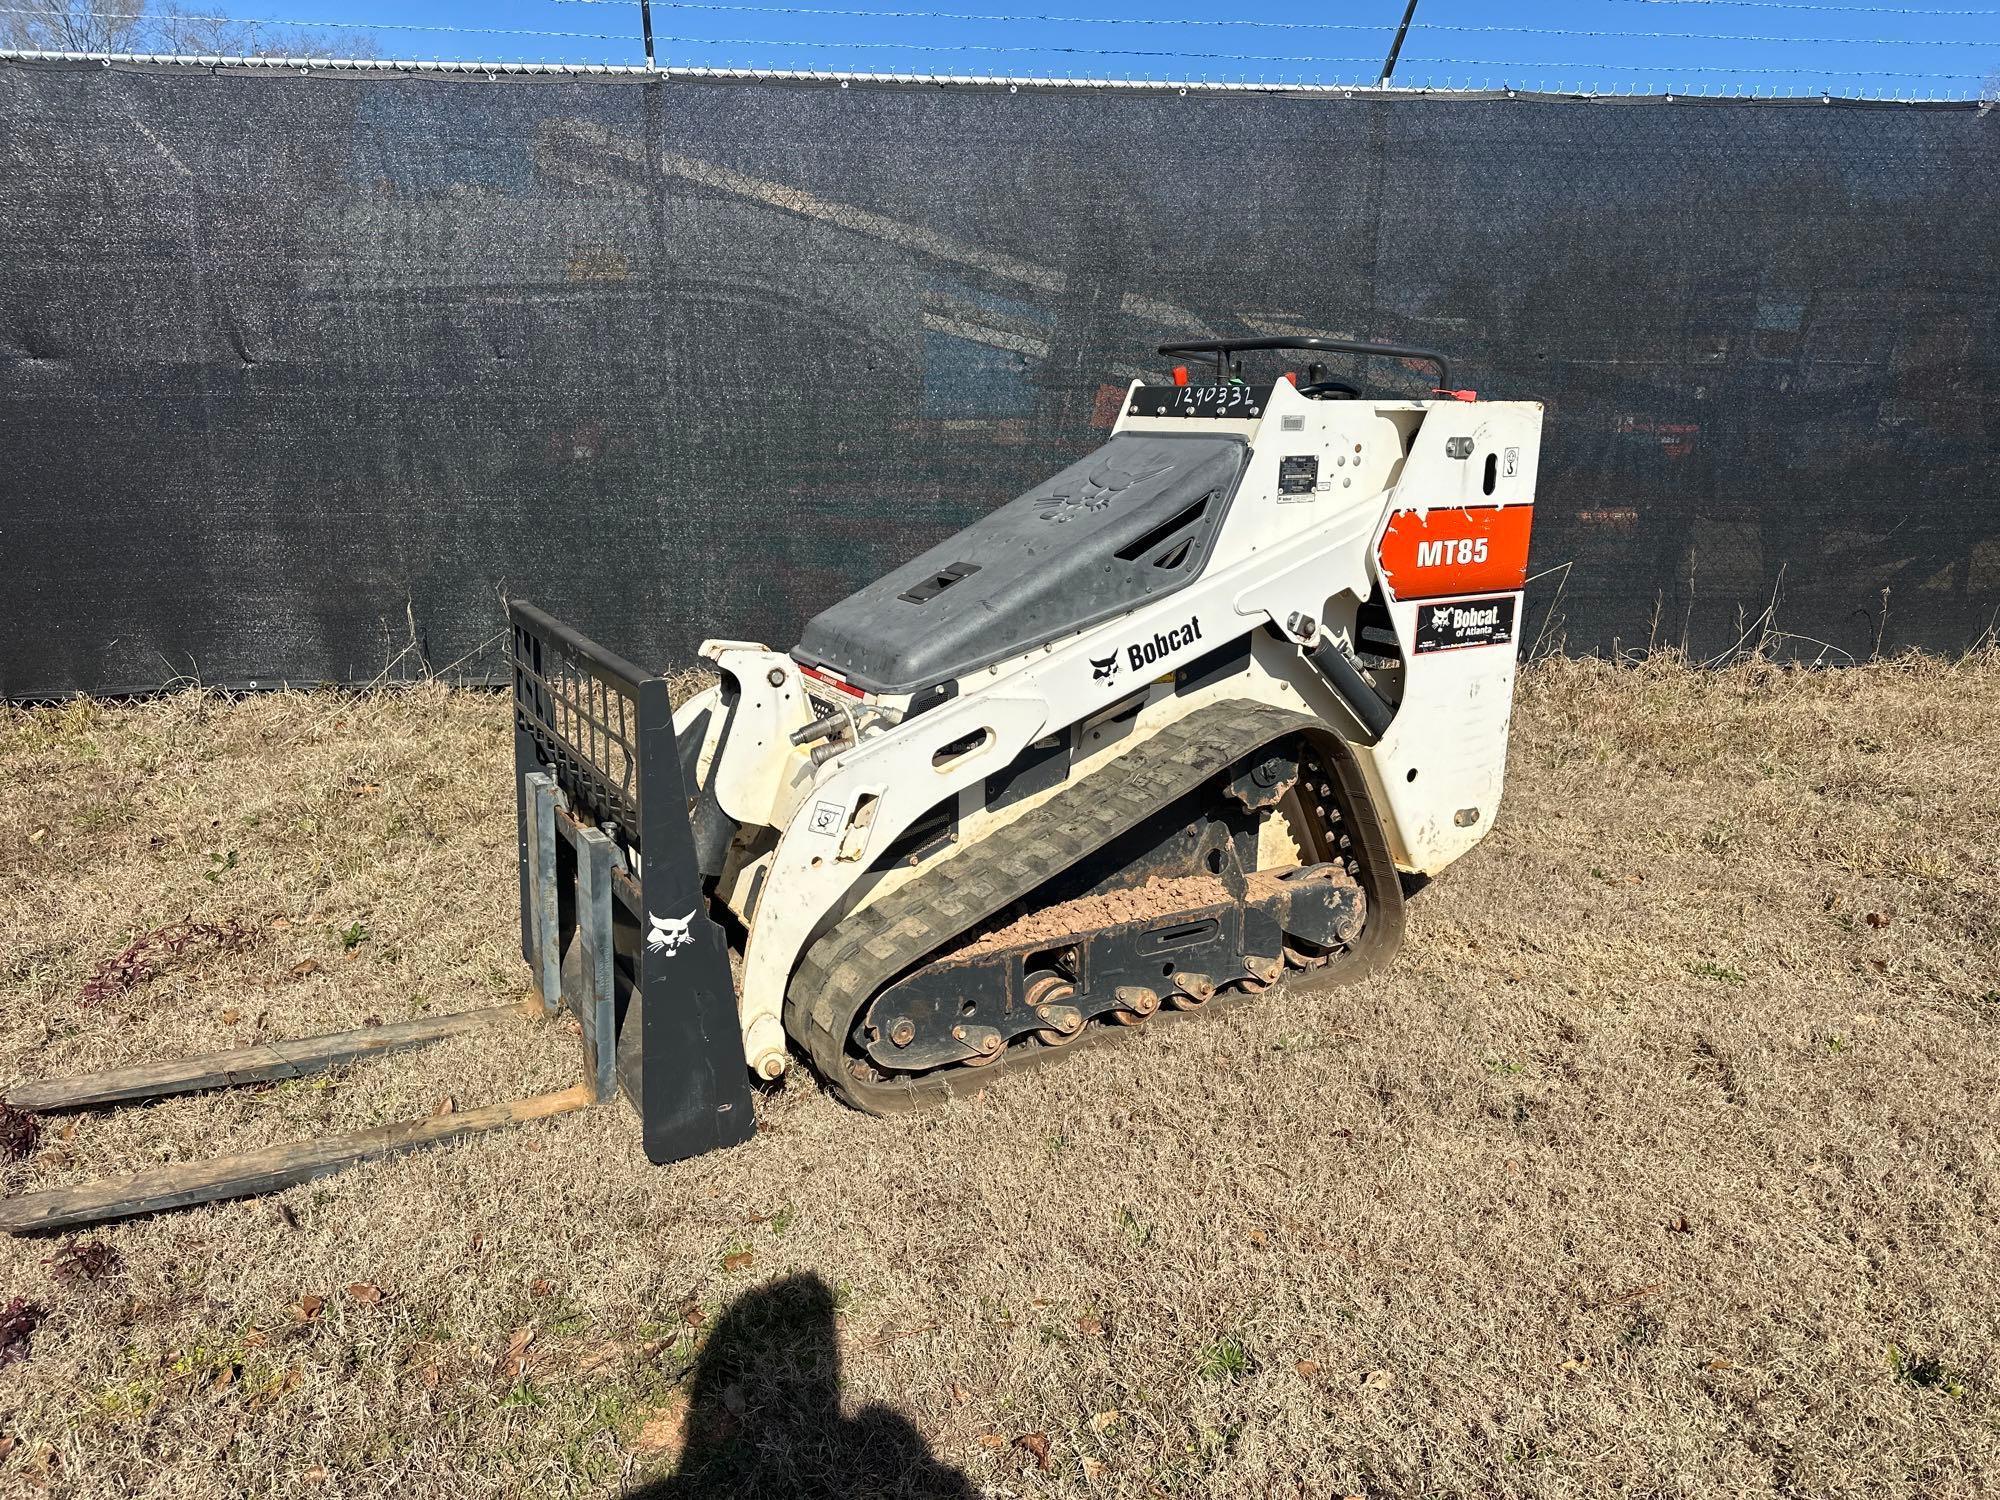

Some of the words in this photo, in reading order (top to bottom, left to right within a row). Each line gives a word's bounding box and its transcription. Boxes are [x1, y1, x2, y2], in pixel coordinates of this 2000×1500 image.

[1174, 386, 1254, 408] 1290332
[1417, 538, 1488, 567] MT85
[1126, 615, 1203, 672] Bobcat
[1455, 627, 1465, 637] of
[1466, 626, 1492, 636] Atlanta
